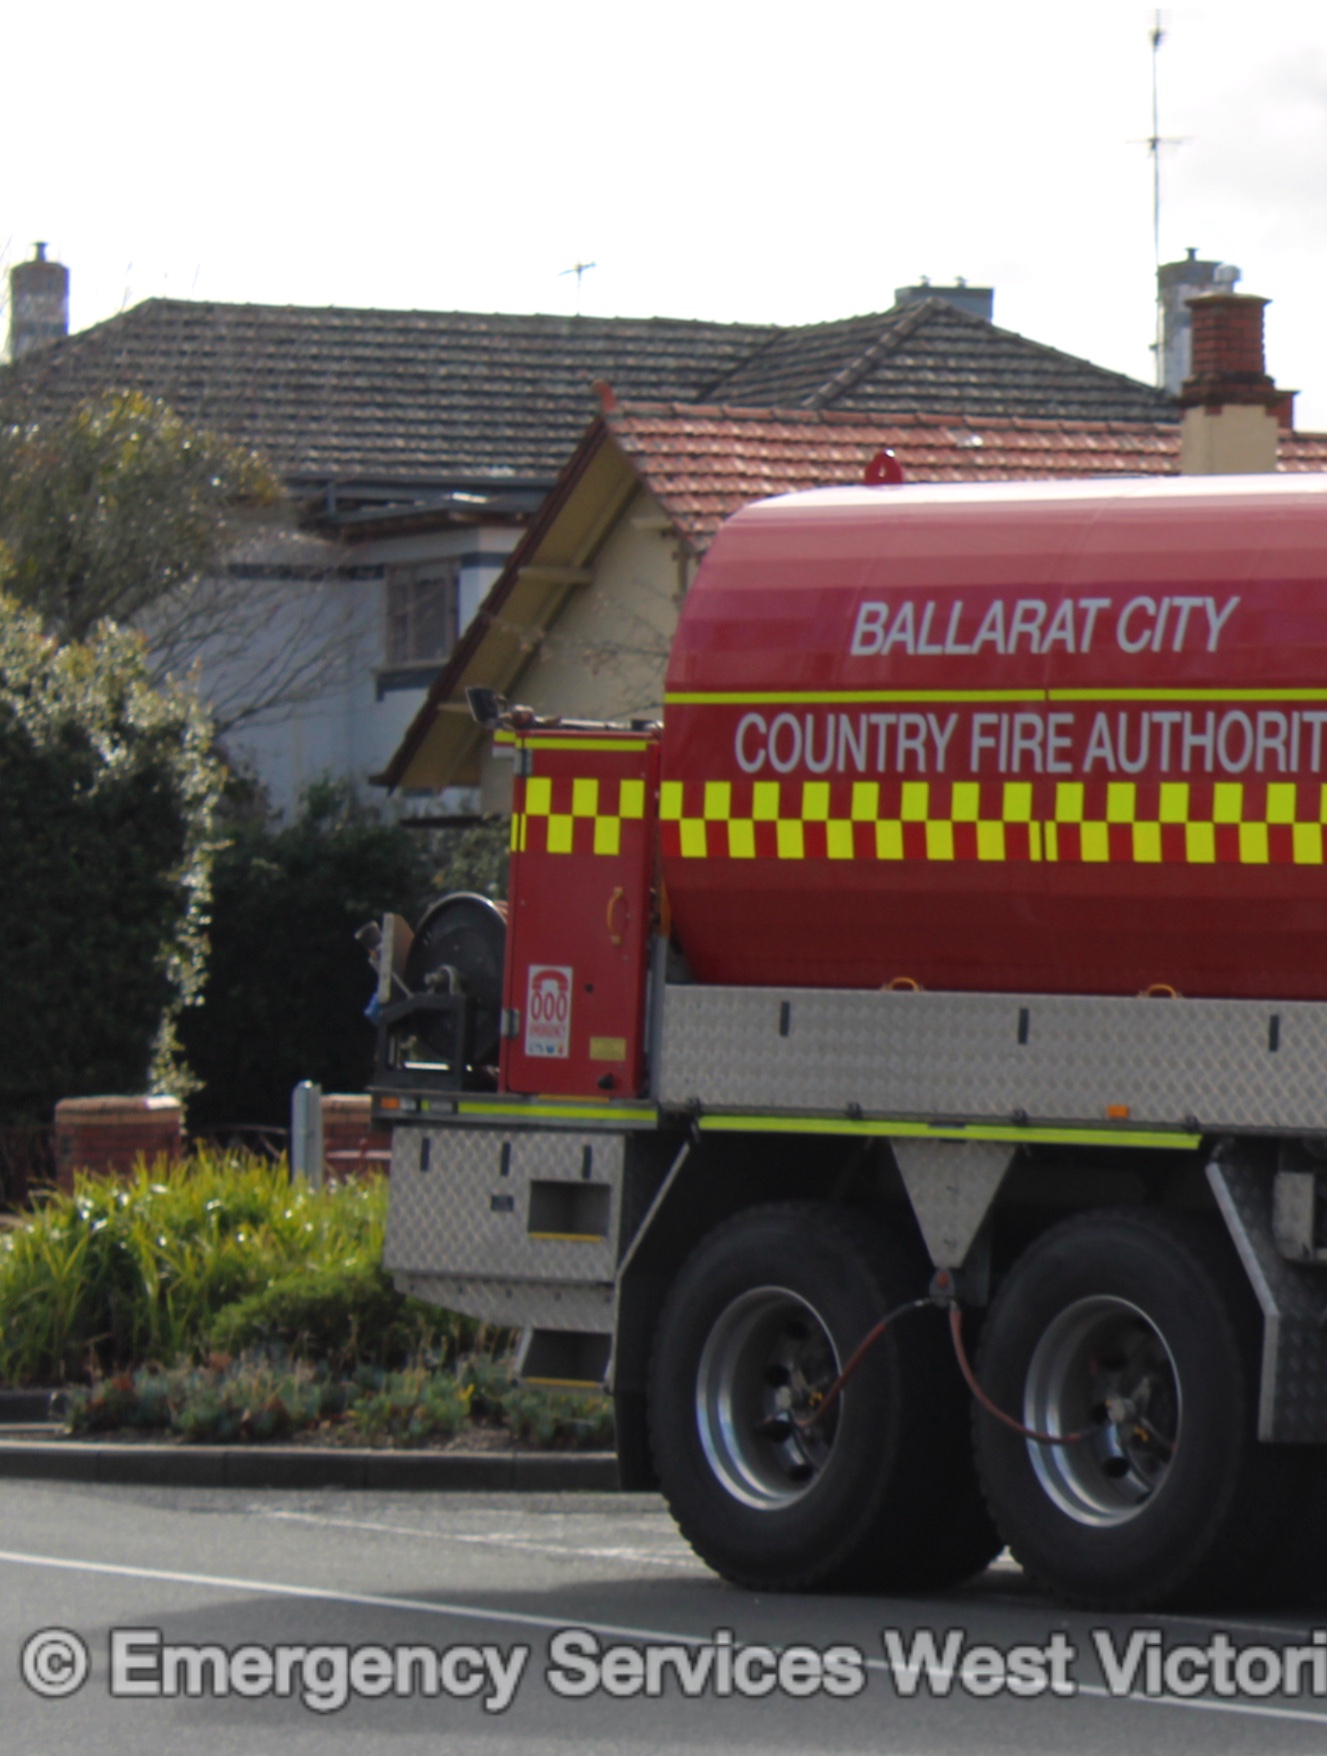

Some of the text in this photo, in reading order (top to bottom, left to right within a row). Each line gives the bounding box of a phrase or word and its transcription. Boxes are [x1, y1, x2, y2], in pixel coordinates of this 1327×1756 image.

[850, 596, 1240, 656] BALLARAT CITY
[735, 712, 958, 774] COUNTRY
[970, 712, 1073, 774] FIRE
[531, 992, 567, 1021] 000
